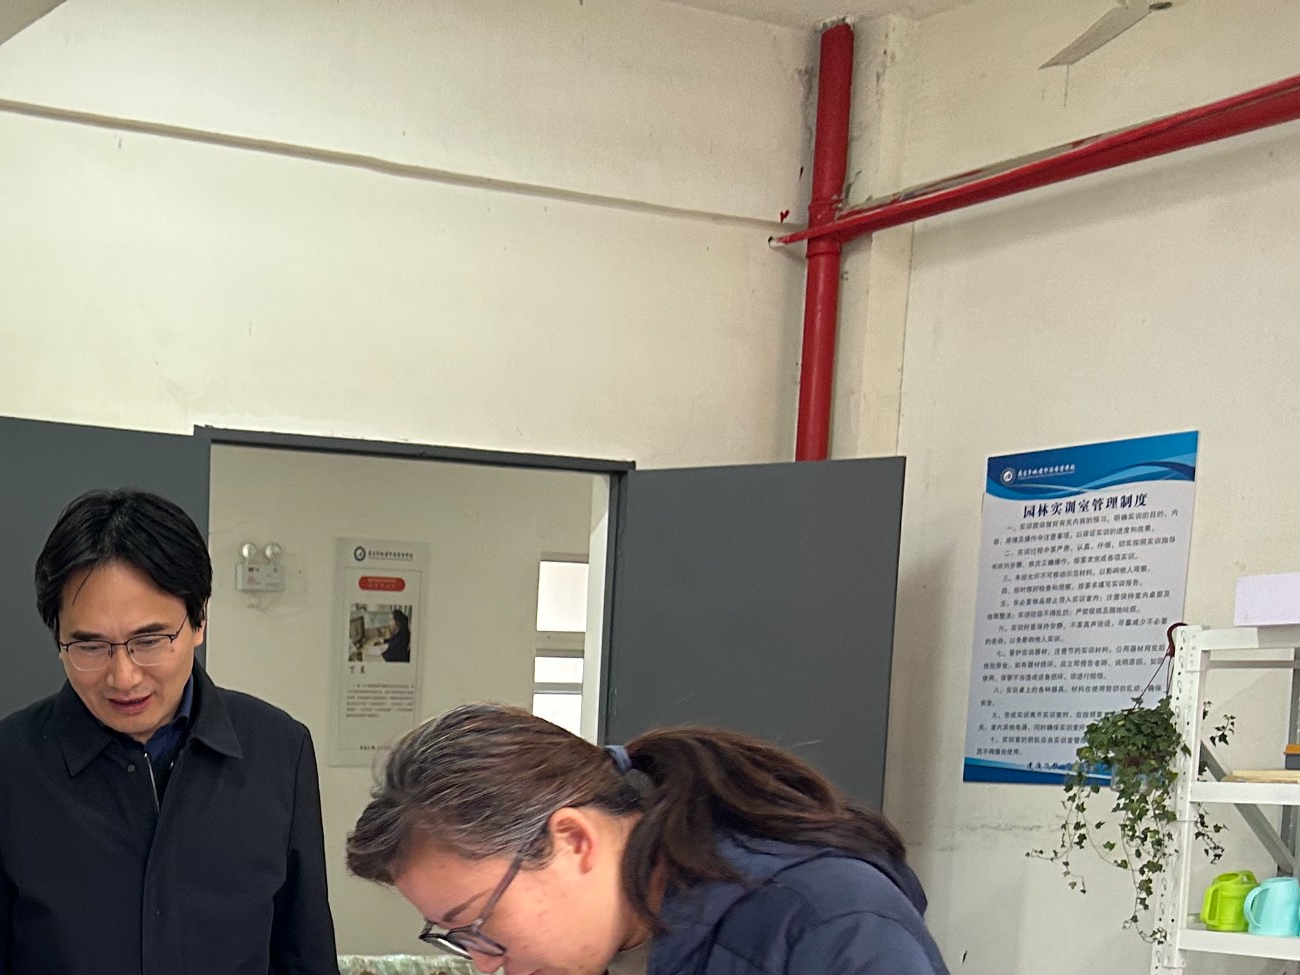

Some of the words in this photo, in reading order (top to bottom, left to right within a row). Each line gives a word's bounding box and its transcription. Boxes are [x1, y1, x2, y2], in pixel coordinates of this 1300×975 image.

[1023, 493, 1148, 518] 园林实训室管理制度
